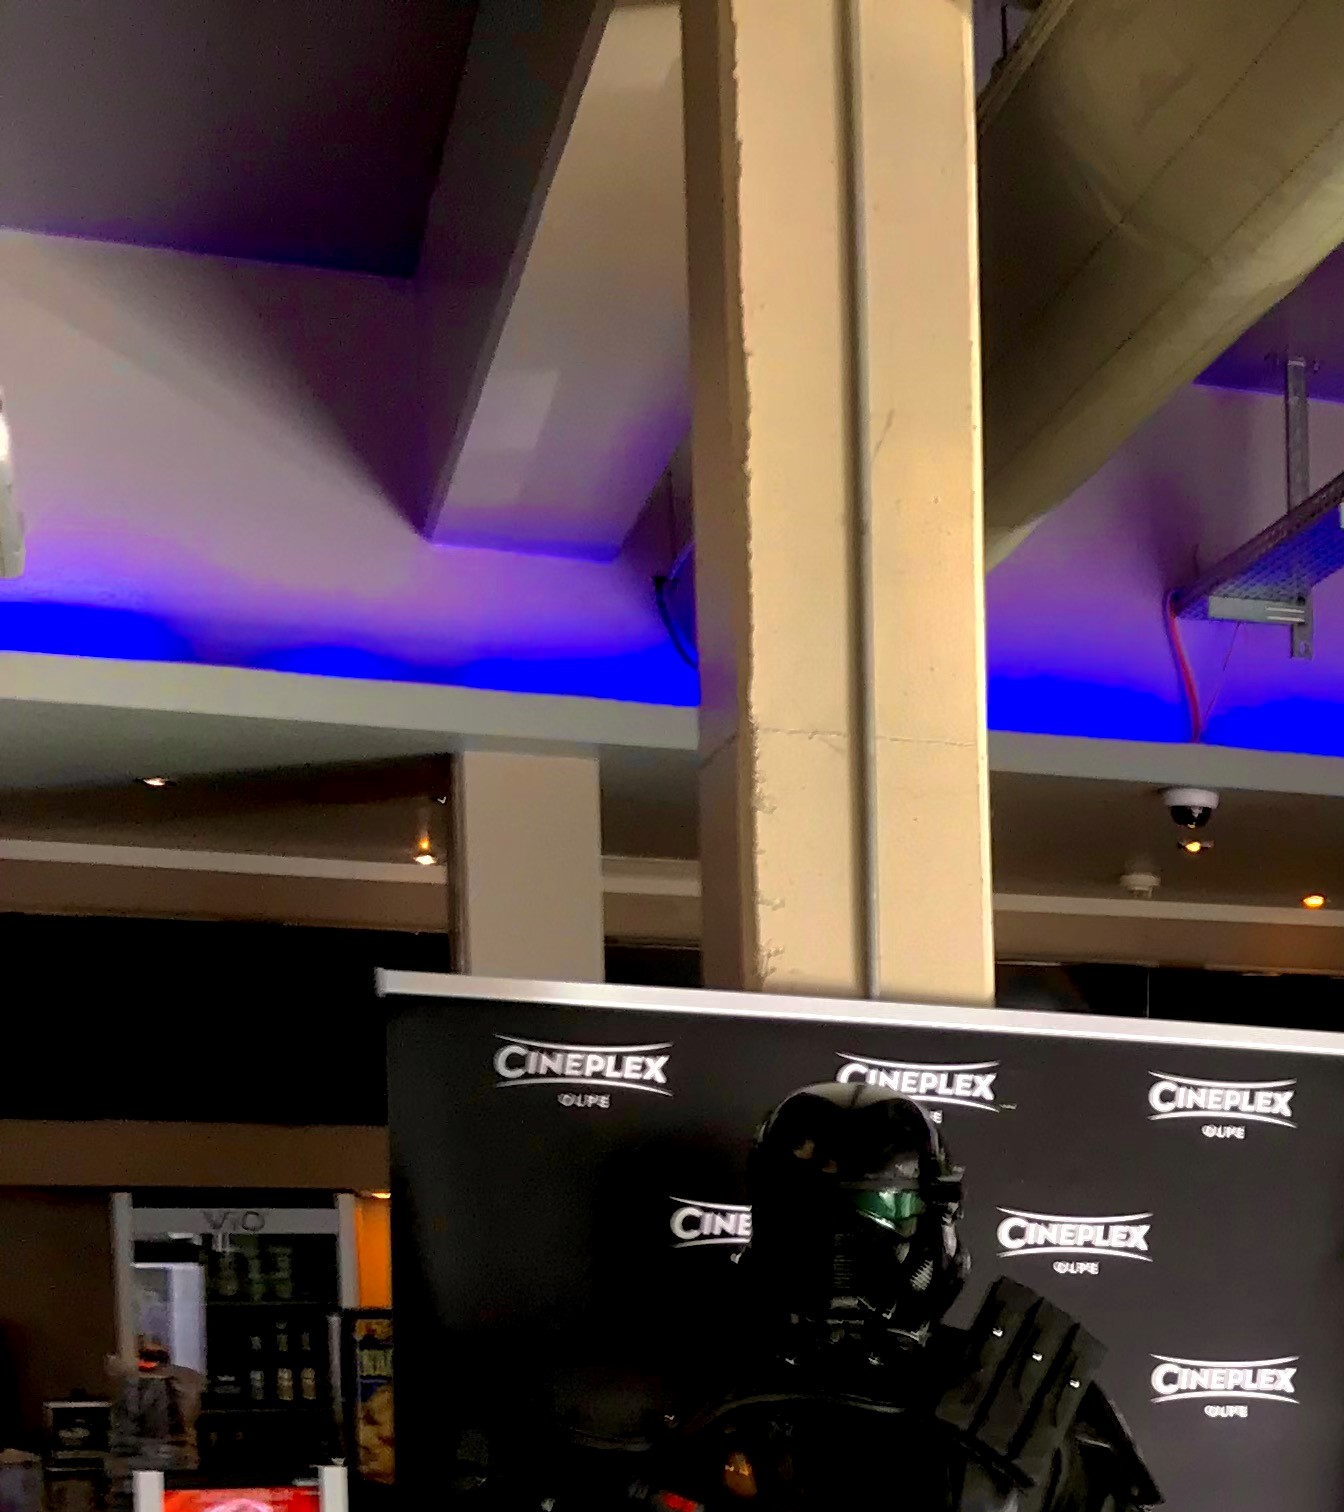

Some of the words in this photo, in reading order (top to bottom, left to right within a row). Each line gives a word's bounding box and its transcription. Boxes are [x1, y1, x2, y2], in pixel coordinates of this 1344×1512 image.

[493, 1045, 671, 1084] CINEPLEX
[1148, 1080, 1296, 1117] CINEPLEX
[670, 1206, 753, 1240] CINE
[997, 1216, 1151, 1251] CINEPLEX
[1151, 1363, 1298, 1395] CINEPLEX
